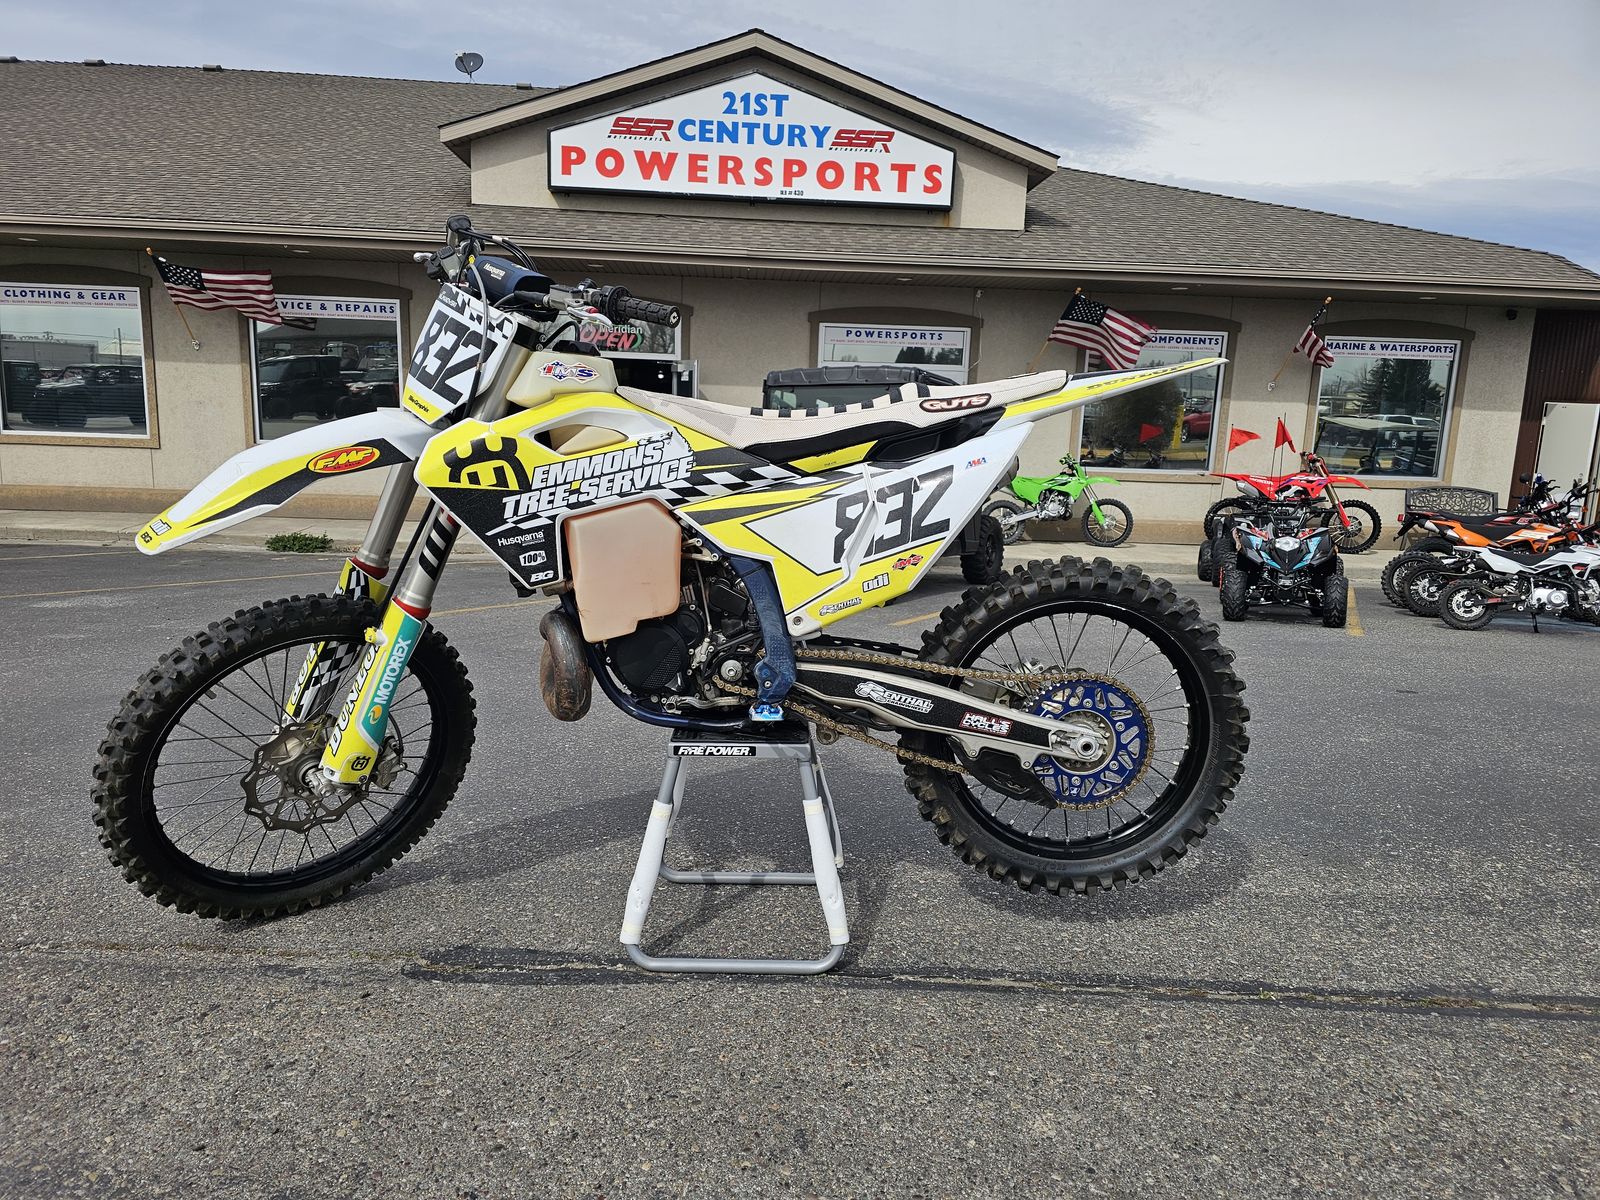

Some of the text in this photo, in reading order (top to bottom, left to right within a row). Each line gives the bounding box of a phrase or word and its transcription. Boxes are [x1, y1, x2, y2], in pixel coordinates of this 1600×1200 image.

[722, 91, 789, 118] 21ST
[609, 117, 674, 141] SSR
[678, 119, 831, 148] CENTURY
[831, 129, 895, 153] SSR
[560, 145, 943, 194] POWERSPORTS
[4, 289, 126, 301] CLOTHING & GEAR
[319, 302, 327, 311] &
[335, 303, 395, 314] REPAIRS
[846, 329, 943, 341] POWERSPORTS
[409, 309, 498, 405] 832
[1326, 342, 1454, 354] MARINE & WATERSPORTS
[924, 395, 989, 411] GUTS
[314, 447, 374, 470] FMF
[531, 440, 666, 490] EMMONS
[965, 456, 987, 469] AMA
[502, 455, 696, 520] TREE SERVICE
[497, 531, 544, 547] Husqvarna
[522, 552, 546, 565] 100%
[530, 570, 554, 583] BG
[862, 572, 890, 593] odi
[373, 638, 412, 705] MOTOREX
[328, 645, 381, 758] DUNLO
